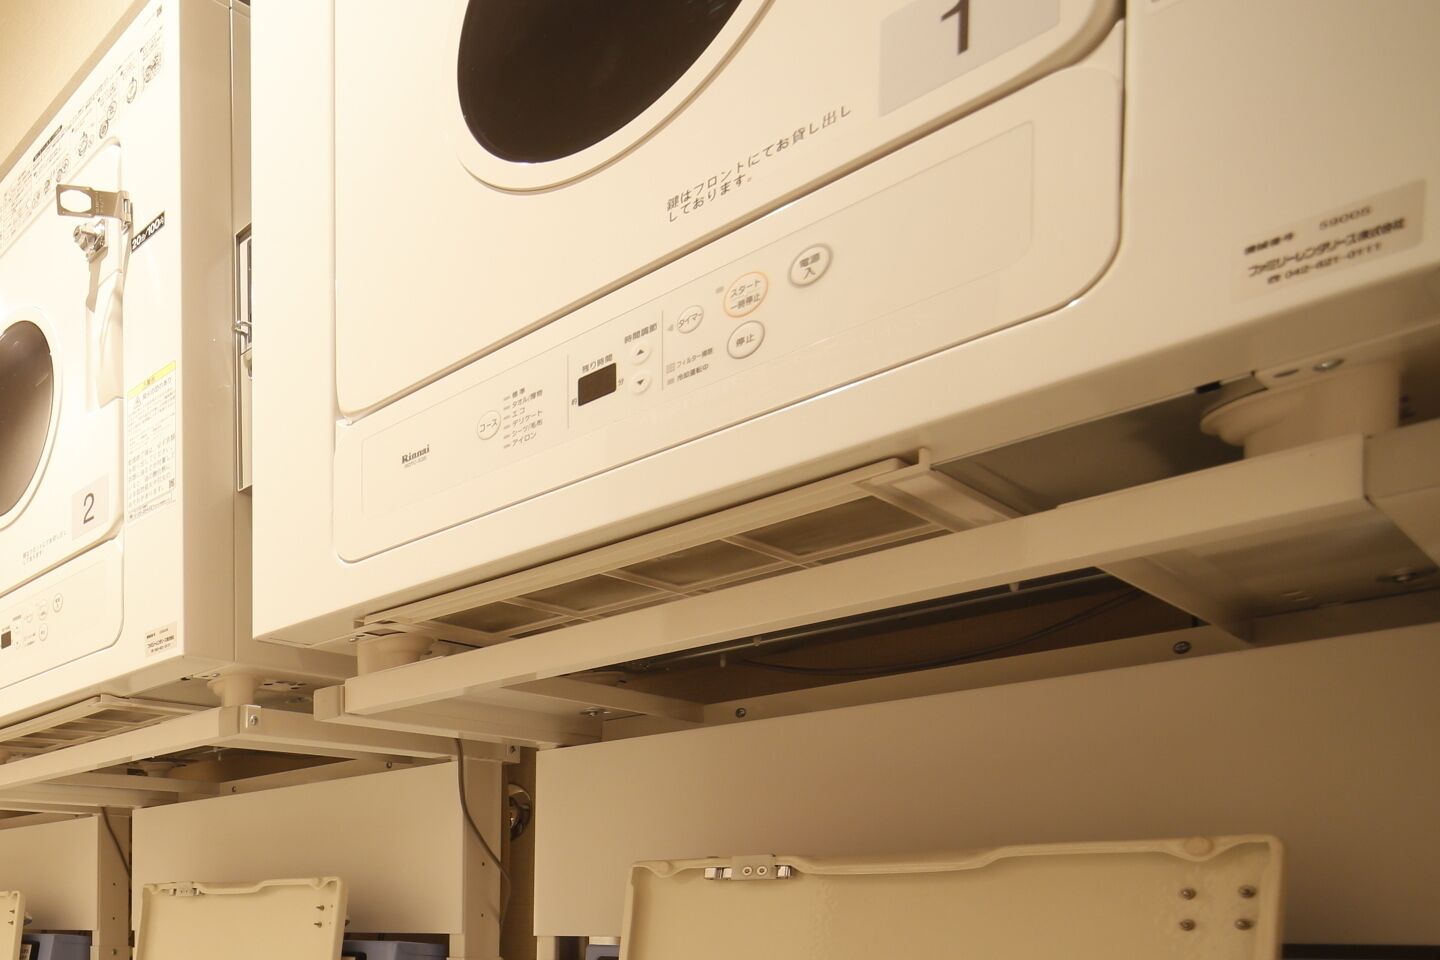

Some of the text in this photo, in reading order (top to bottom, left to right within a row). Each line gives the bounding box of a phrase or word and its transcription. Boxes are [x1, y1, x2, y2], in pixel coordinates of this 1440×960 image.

[940, 0, 969, 55] 1
[666, 105, 851, 211] 鍵はフロントにてお貸し出し
[668, 175, 753, 223] しております。
[803, 267, 817, 279] 入
[730, 280, 761, 298] スタート
[677, 313, 703, 329] タイマー
[735, 333, 755, 347] 停止
[479, 418, 498, 433] コース
[512, 432, 537, 446] アイロン
[401, 444, 430, 464] Rinnai
[83, 492, 95, 524] 2
